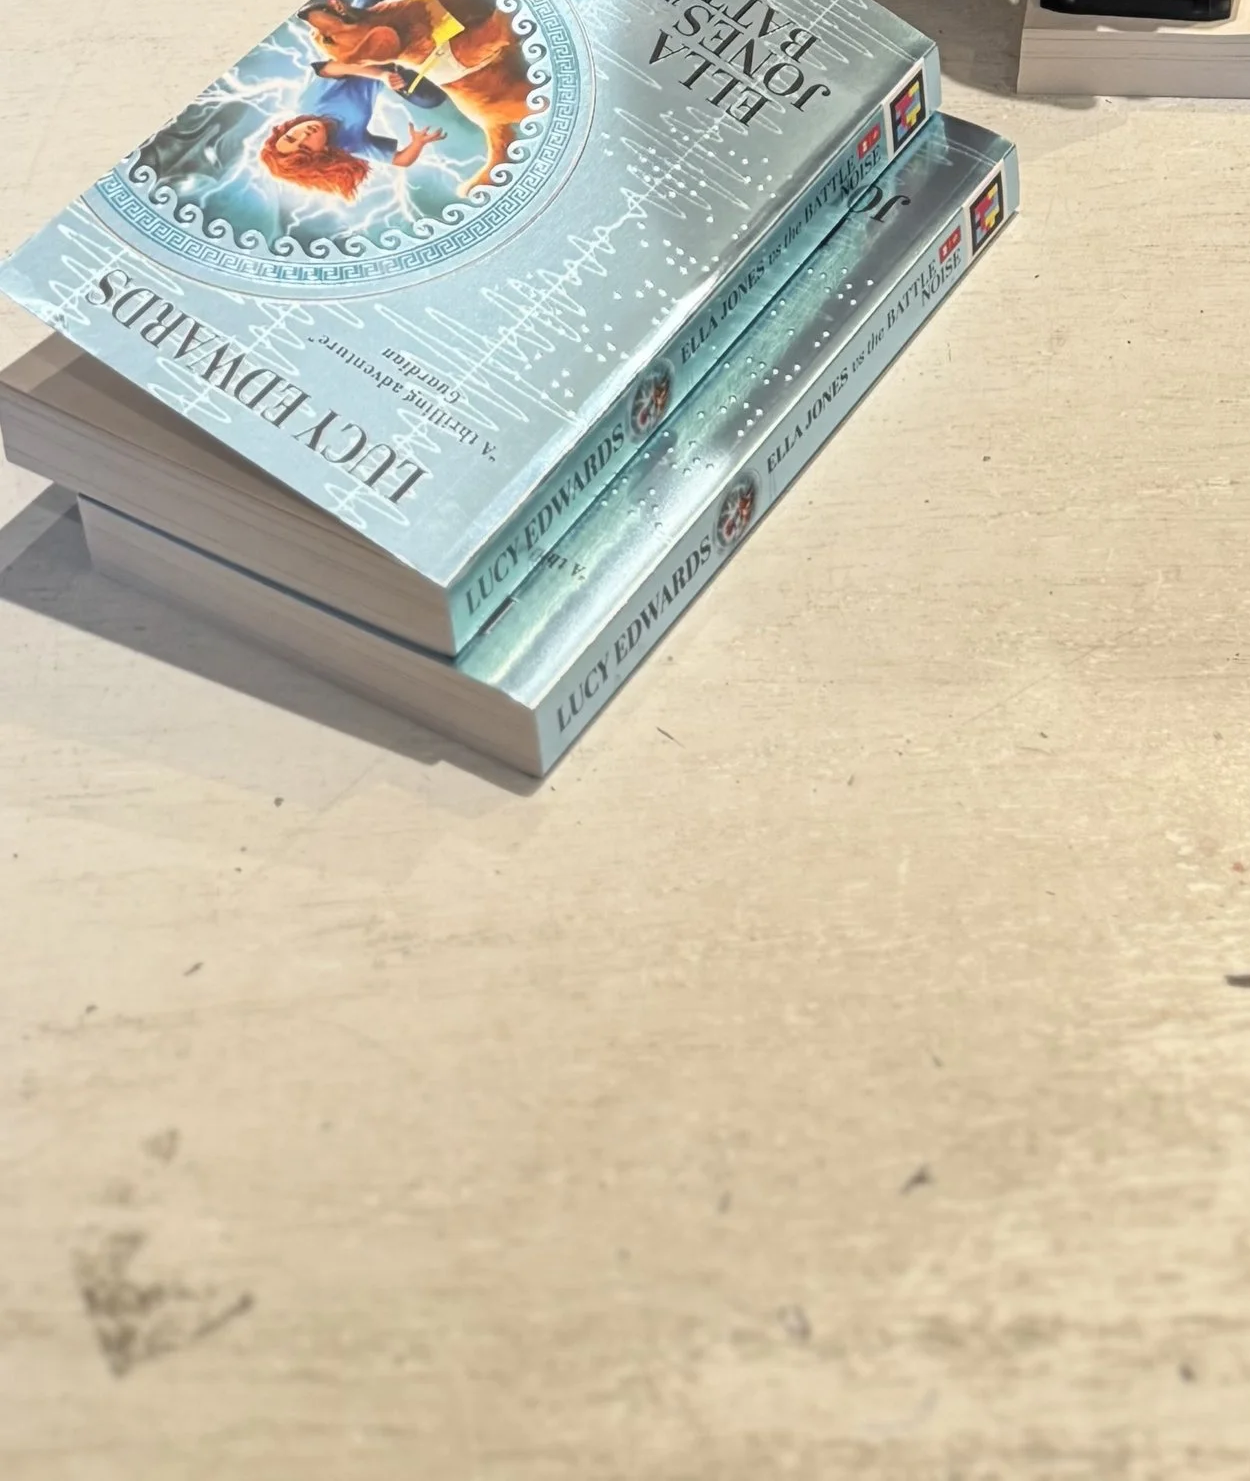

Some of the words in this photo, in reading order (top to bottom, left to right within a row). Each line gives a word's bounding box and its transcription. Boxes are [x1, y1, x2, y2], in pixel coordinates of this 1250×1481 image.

[648, 28, 772, 128] ELLA
[672, 4, 832, 113] JONES
[839, 144, 883, 204] NOISE
[680, 318, 721, 365] ELLA
[720, 260, 766, 321] JONES
[767, 243, 782, 267] vs
[782, 218, 804, 248] the
[803, 156, 857, 228] BATTLE
[921, 247, 963, 307] NOISE
[84, 268, 311, 429] EDWARDS
[381, 348, 461, 404] Guardian
[766, 424, 804, 475] ELLA
[804, 366, 850, 430] JONES
[852, 346, 866, 372] vs
[866, 327, 885, 357] the
[886, 258, 936, 331] BATTLE
[294, 407, 430, 506] LUCY
[402, 388, 479, 445] thrilling
[464, 546, 519, 616] LUCY
[522, 423, 626, 552] EDWARDS
[556, 654, 610, 735] LUCY
[613, 535, 712, 666] EDWARDS
